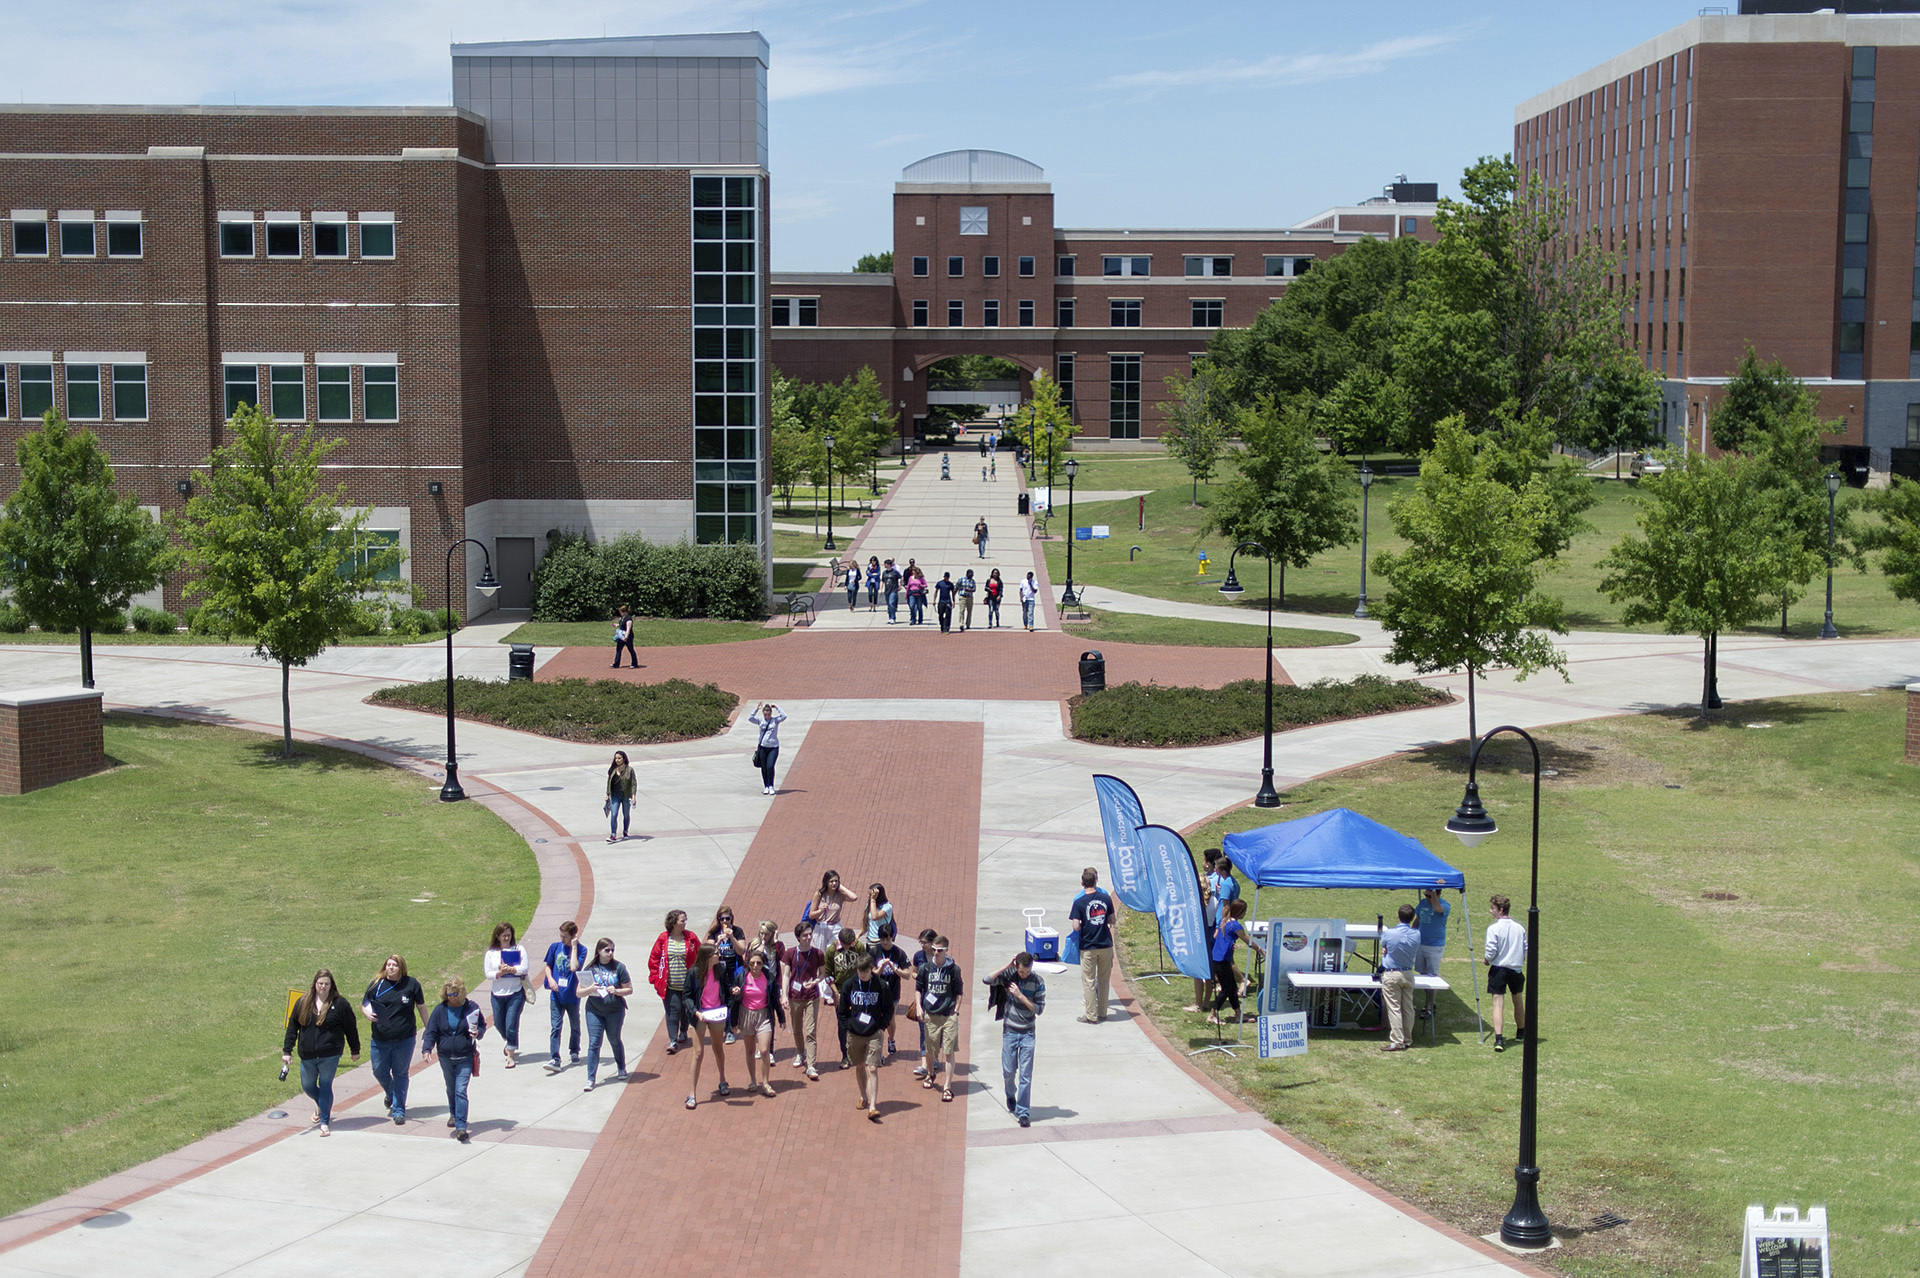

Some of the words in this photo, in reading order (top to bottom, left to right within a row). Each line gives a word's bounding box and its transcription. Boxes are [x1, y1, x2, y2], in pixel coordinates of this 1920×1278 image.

[850, 990, 879, 1006] MTSU
[1271, 1021, 1304, 1032] STUDENT
[1260, 1017, 1268, 1057] CUSTOMS
[1277, 1030, 1300, 1041] UNION
[1271, 1038, 1305, 1050] BUILDING
[1757, 1243, 1789, 1253] WELCOME
